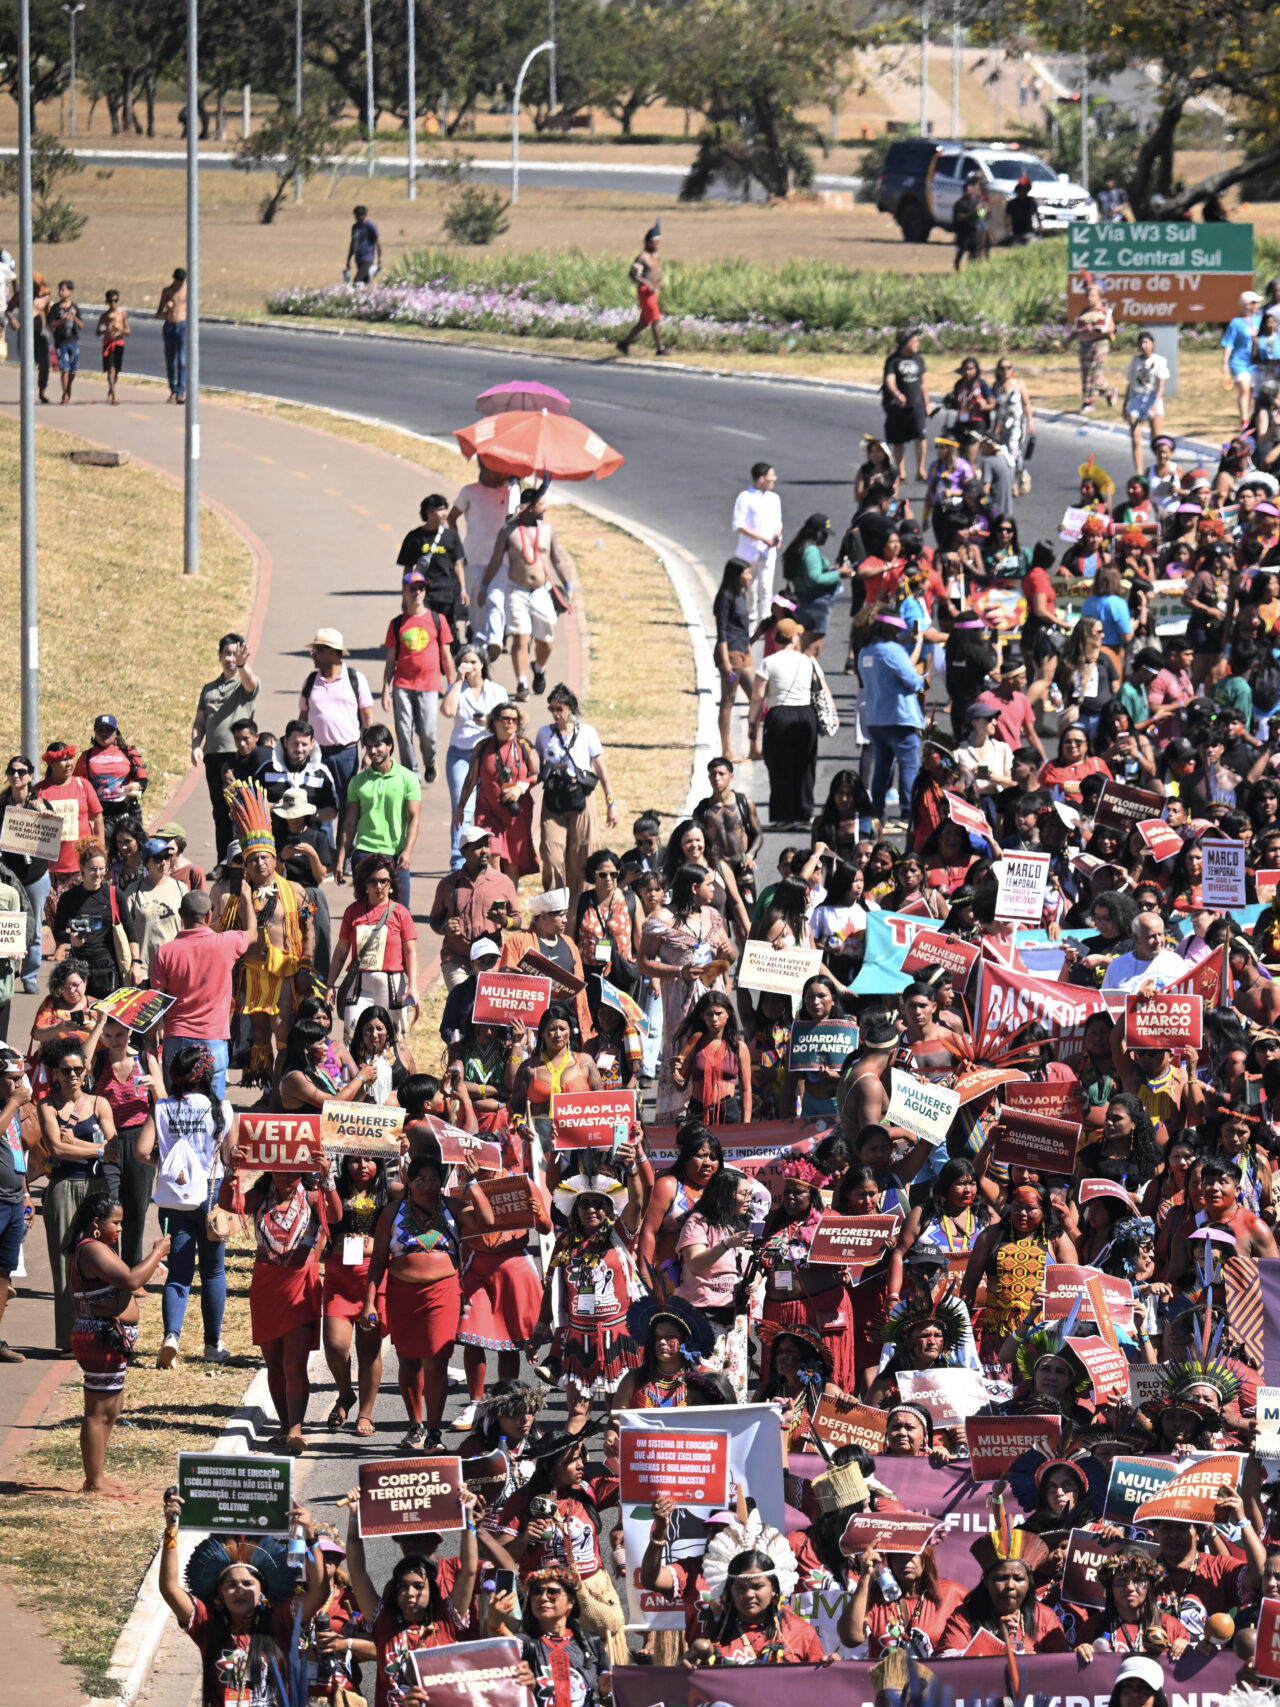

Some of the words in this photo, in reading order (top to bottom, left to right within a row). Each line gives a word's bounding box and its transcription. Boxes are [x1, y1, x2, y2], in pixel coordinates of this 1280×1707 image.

[1095, 224, 1126, 242] Via
[1130, 224, 1160, 242] W3
[1165, 224, 1197, 242] Sul
[1093, 251, 1112, 267] Z.
[1117, 250, 1185, 267] Central
[1190, 250, 1221, 267] Sul
[1097, 274, 1141, 292] orre
[1146, 275, 1172, 292] de
[1175, 275, 1201, 292] TV
[1122, 299, 1177, 316] Tower
[1103, 793, 1160, 817] REFLORESTAR
[1112, 805, 1146, 821] MENTES
[8, 819, 25, 827] PELO
[25, 822, 41, 830] BEM
[41, 825, 60, 833] VIVER
[1208, 850, 1239, 866] MARCO
[1006, 862, 1042, 879] MARCO
[749, 952, 769, 961] PELO
[770, 955, 787, 964] BEM
[786, 958, 812, 967] VIVER
[919, 940, 966, 966] MULHERES
[750, 958, 765, 966] DAS
[764, 961, 809, 973] MULHERES
[909, 948, 967, 976] ANCESTRAIS
[480, 985, 544, 1000] MULHERES
[488, 998, 536, 1011] TERRAS
[1136, 1000, 1168, 1014] NÃO
[1169, 1002, 1191, 1014] AO
[1136, 1014, 1191, 1026] MARCO
[799, 1032, 852, 1046] GUARDIÃS
[1136, 1027, 1190, 1037] TEMPORAL
[793, 1044, 808, 1054] DO
[808, 1042, 855, 1054] PLANETA
[896, 1083, 952, 1116] MULHERES
[1010, 1095, 1031, 1105] NÃO
[1034, 1095, 1049, 1105] AO
[557, 1104, 583, 1116] NÃO
[584, 1104, 598, 1114] AO
[599, 1104, 614, 1114] PL
[615, 1103, 631, 1113] DA
[904, 1096, 940, 1122] ÁGUAS
[328, 1112, 397, 1128] MULHERES
[559, 1114, 631, 1129] DEVASTAÇÃO
[244, 1120, 316, 1142] VETA
[337, 1122, 383, 1139] ÁGUAS
[1009, 1130, 1051, 1146] GUARDIÃS
[1052, 1140, 1064, 1148] DA
[246, 1143, 314, 1165] LULA
[660, 1150, 681, 1159] DAS
[736, 1146, 791, 1157] INDÍGENAS
[819, 1227, 890, 1240] REFLORESTAR
[830, 1236, 873, 1248] MENTES
[1091, 1362, 1120, 1374] CONTRA
[1099, 1371, 1123, 1382] MARCO
[1137, 1381, 1160, 1389] PELO
[636, 1439, 647, 1448] UM
[648, 1439, 675, 1449] SISTEMA
[676, 1440, 685, 1449] DE
[686, 1440, 718, 1452] EDUCAÇÃO
[830, 1430, 847, 1444] DA
[850, 1436, 881, 1453] VIDA
[978, 1434, 1049, 1447] MULHERES
[634, 1451, 646, 1460] QUE
[647, 1450, 655, 1460] JÁ
[656, 1452, 677, 1461] NASCE
[677, 1453, 712, 1462] EXCLUINDO
[197, 1466, 237, 1477] SUBSISTEMA
[238, 1468, 246, 1477] DE
[247, 1468, 280, 1481] EDUCAÇÃO
[378, 1472, 429, 1488] CORPO
[431, 1471, 441, 1482] E
[638, 1475, 649, 1483] UM
[650, 1475, 677, 1484] SISTEMA
[677, 1476, 706, 1485] RACISTA!
[184, 1477, 212, 1487] ESCOLAR
[243, 1479, 256, 1489] NÃO
[274, 1482, 285, 1490] EM
[368, 1481, 452, 1500] TERRITÓRIO
[238, 1491, 278, 1503] CONSTRUÇÃO
[391, 1499, 413, 1511] EM
[414, 1494, 432, 1509] PÉ
[218, 1502, 249, 1512] COLETIVA!
